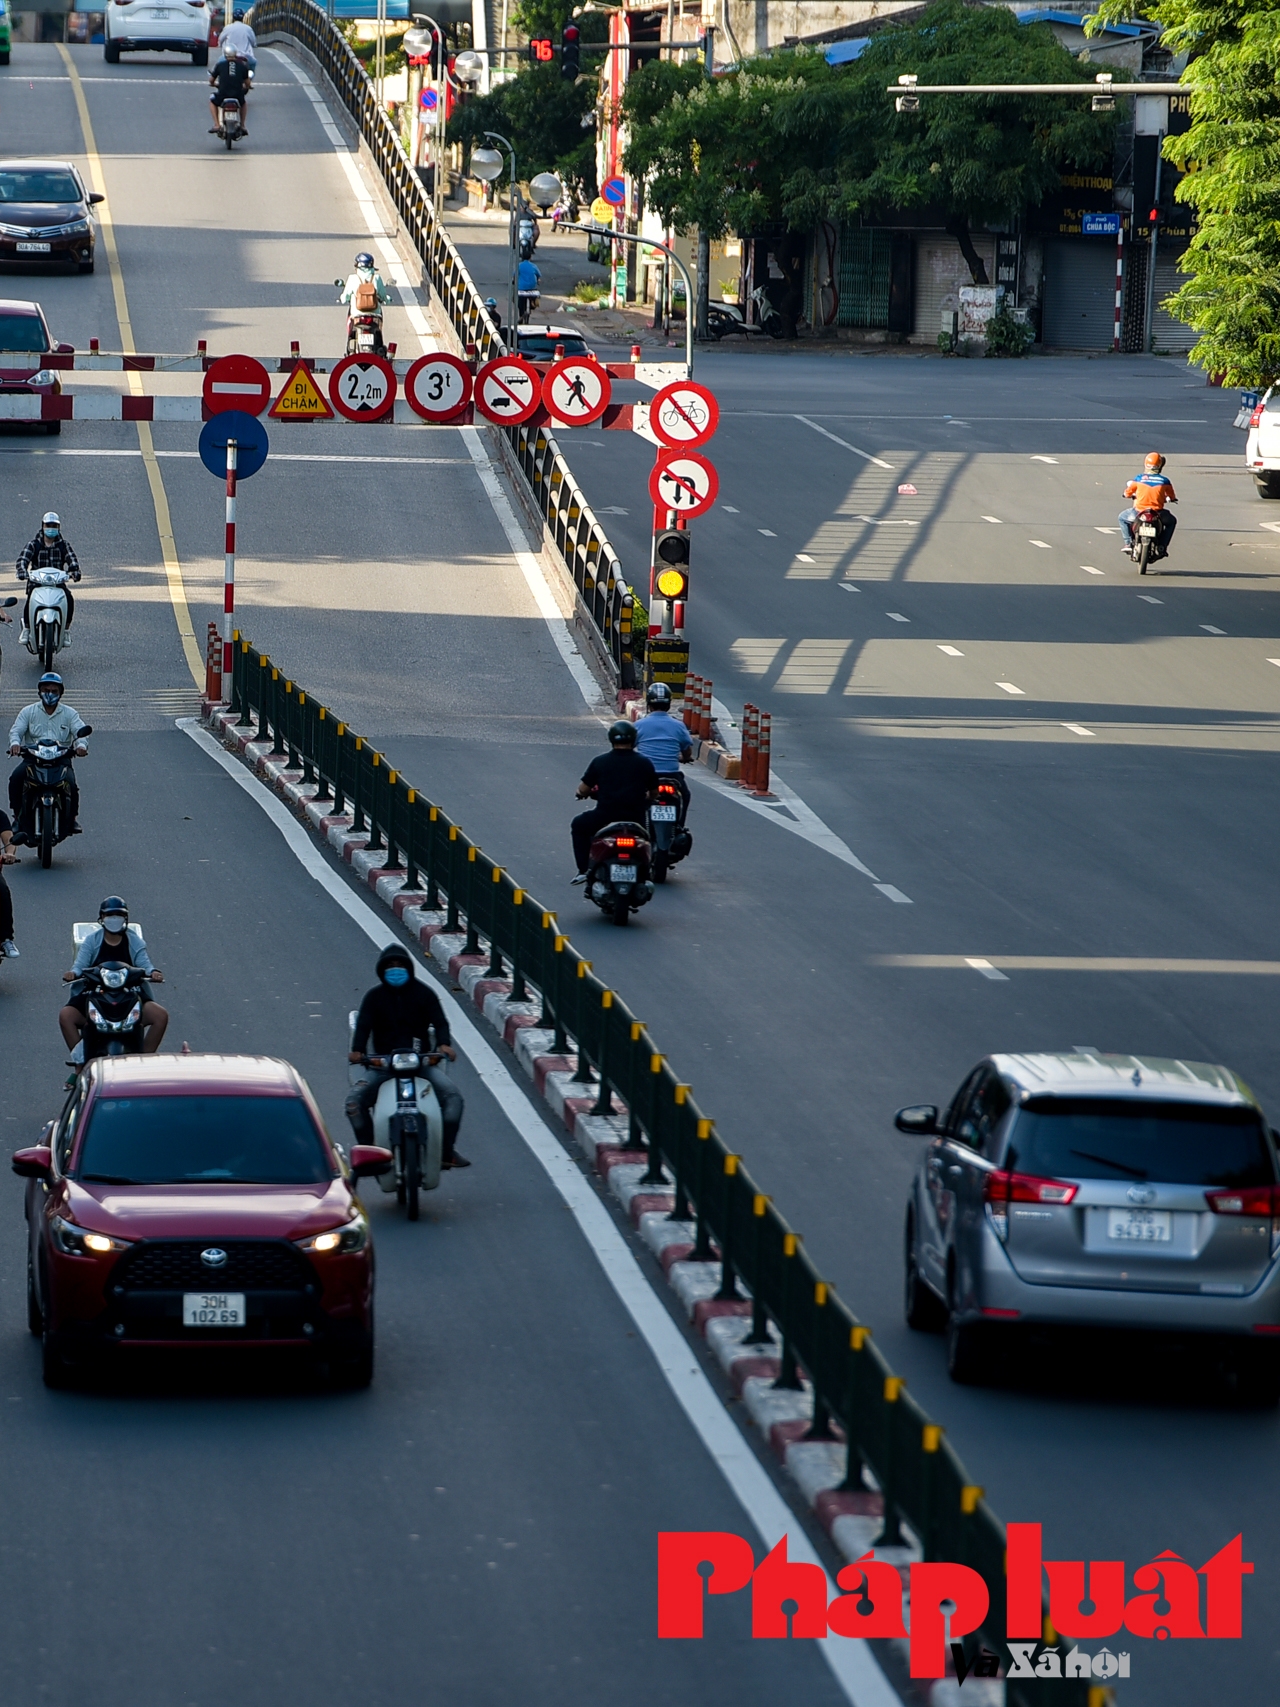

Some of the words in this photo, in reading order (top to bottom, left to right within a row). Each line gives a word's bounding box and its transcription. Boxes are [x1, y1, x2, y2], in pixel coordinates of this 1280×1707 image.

[531, 40, 552, 61] 76
[1086, 222, 1102, 231] CHÙA
[1103, 221, 1116, 232] BỘC
[295, 383, 307, 395] ĐI
[347, 373, 382, 401] 2,2m
[282, 397, 318, 411] CHẬM
[200, 1295, 227, 1309] 30H
[191, 1309, 239, 1323] 102.69
